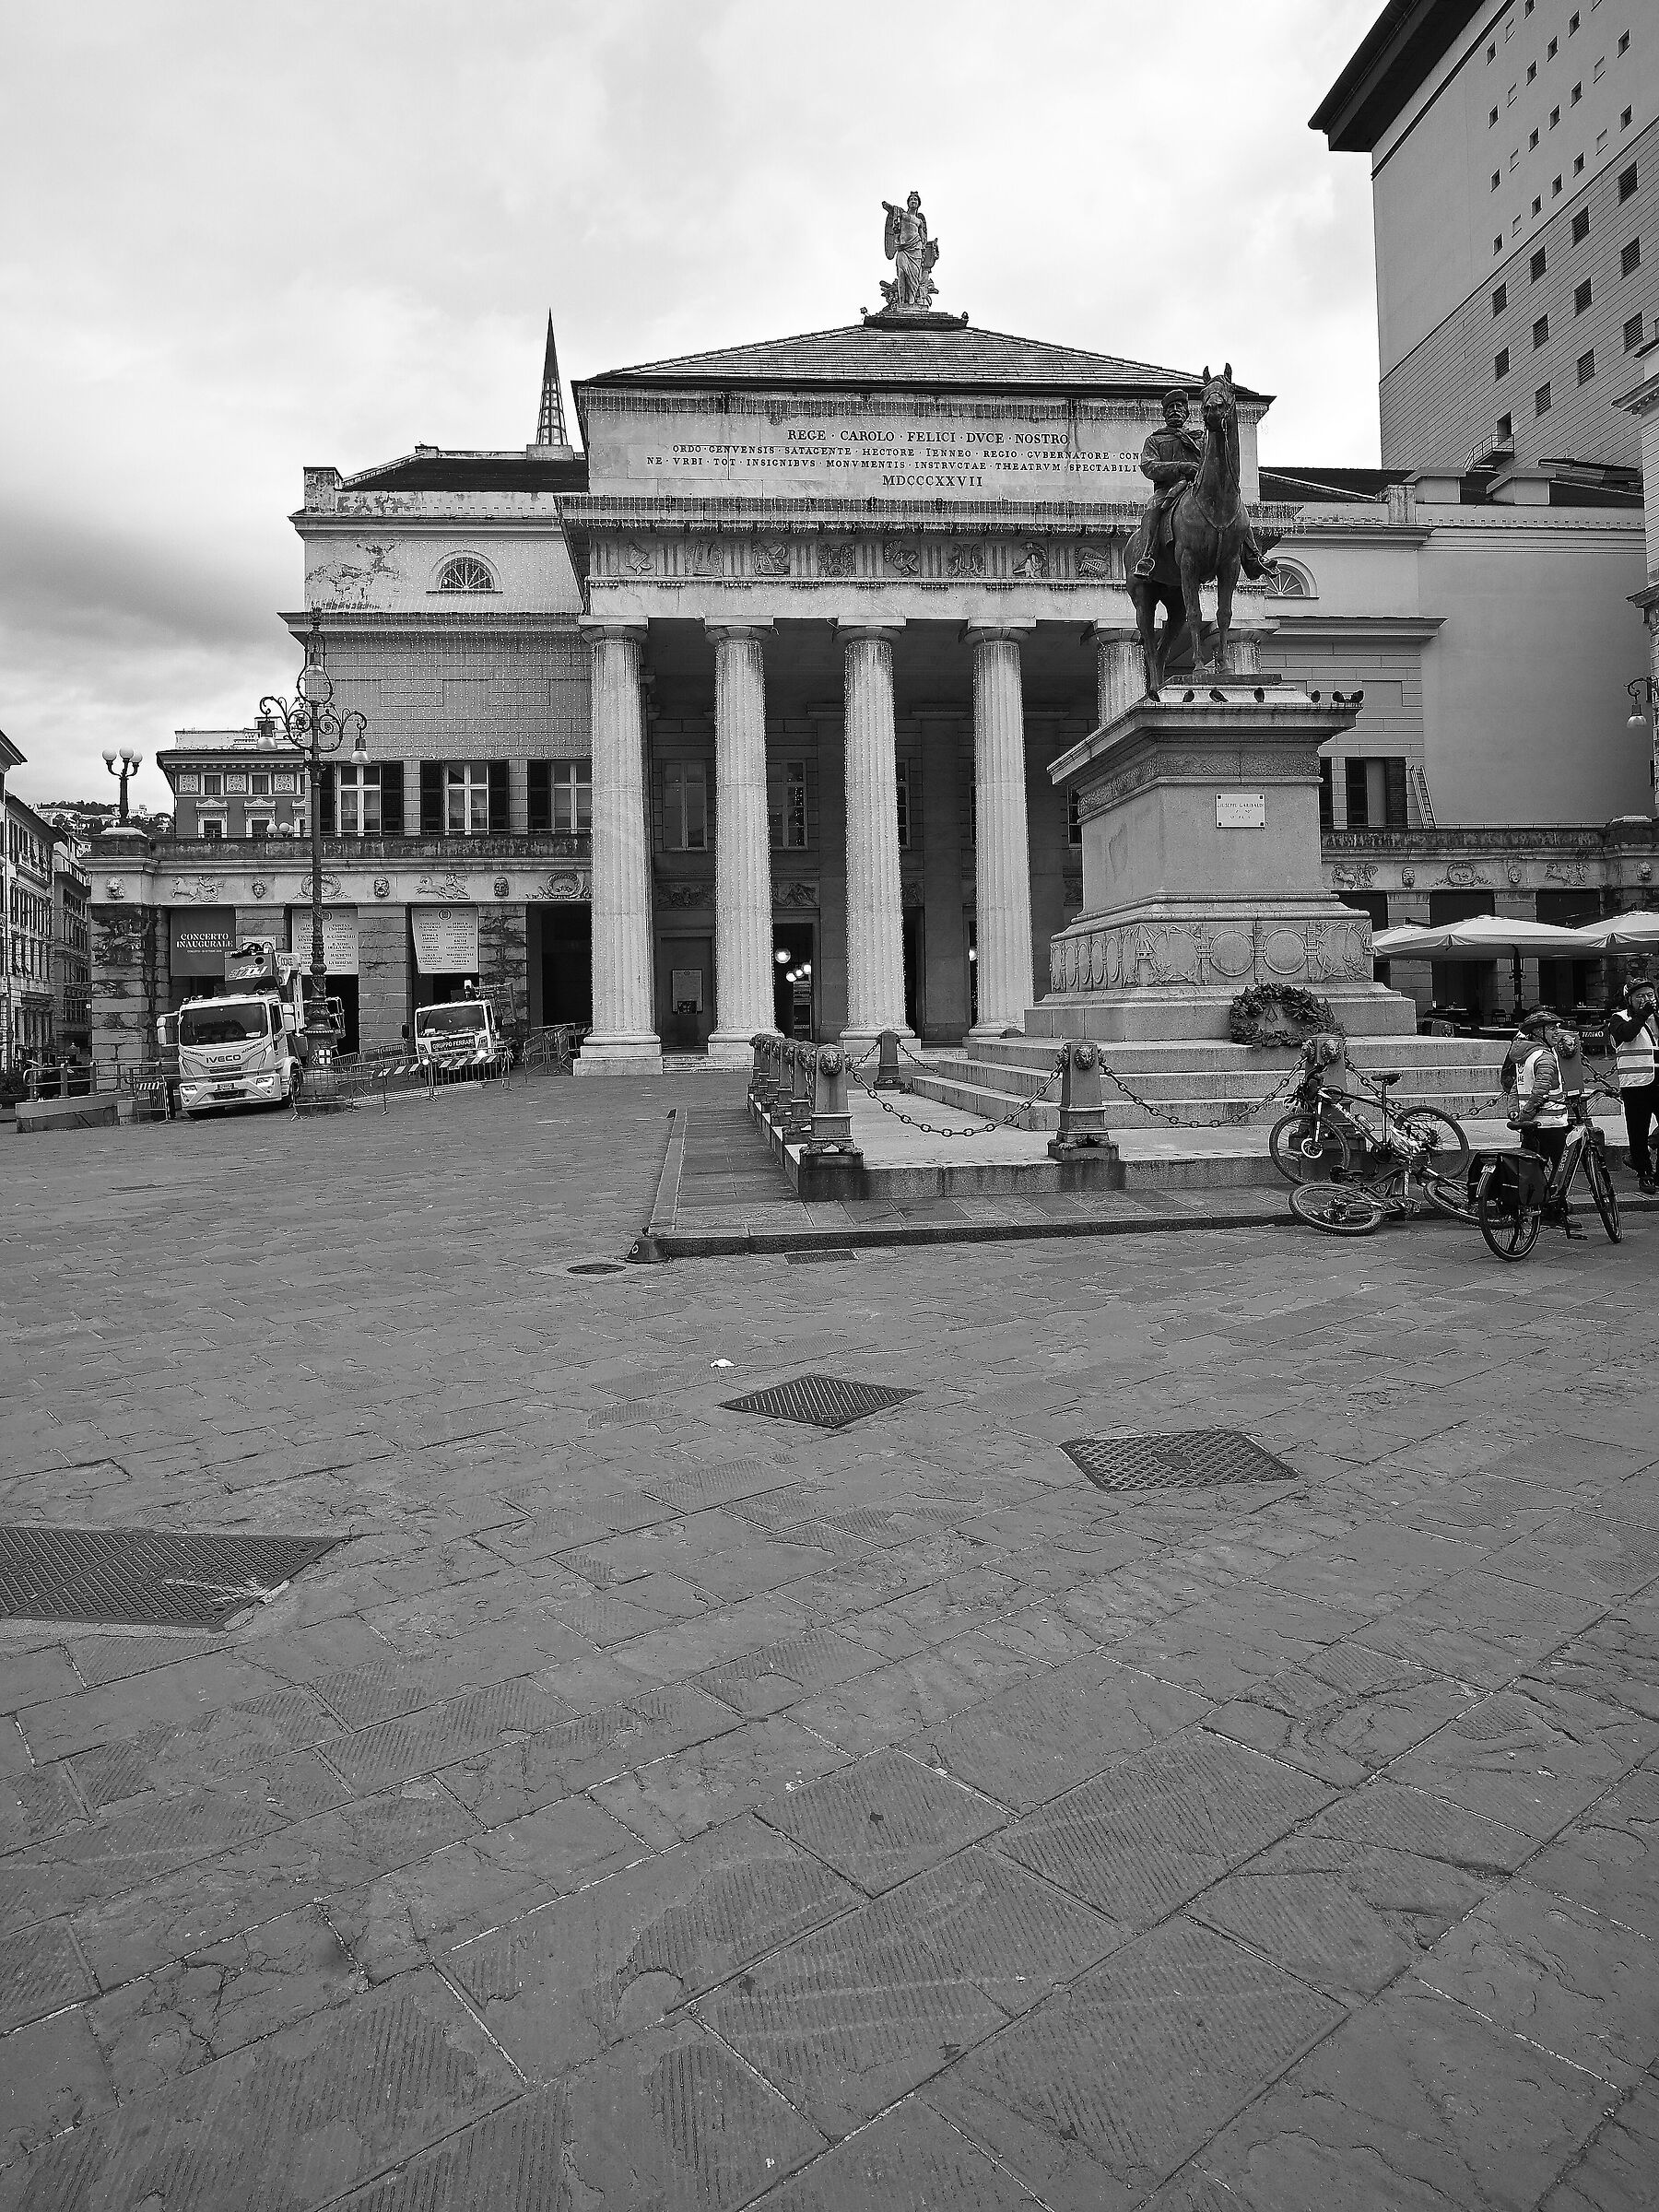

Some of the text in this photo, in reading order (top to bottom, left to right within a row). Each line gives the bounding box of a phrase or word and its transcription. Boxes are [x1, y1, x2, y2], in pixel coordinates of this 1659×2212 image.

[787, 429, 1069, 445] REGE CAROLO FELICI DVCE NOSTRO
[672, 444, 702, 453] ORDO
[709, 445, 776, 454] GENVENSIS
[784, 447, 853, 456] SATAGENTE
[862, 448, 915, 457] HECTORE
[982, 450, 1018, 458] REGIO
[1027, 450, 1110, 460] GVBERNATORE
[646, 456, 663, 465] NE
[672, 457, 703, 466] VRBI
[712, 458, 736, 466] TOT
[746, 458, 817, 467] INSIGNIBVS
[826, 459, 906, 469] MONVMENTIS
[914, 461, 987, 470] INSTRVCTAE
[994, 462, 1061, 471] THEATRVM
[882, 475, 983, 488] MDCCCXXVII
[176, 940, 233, 948] INAUGURALE
[206, 1054, 241, 1065] IVECO
